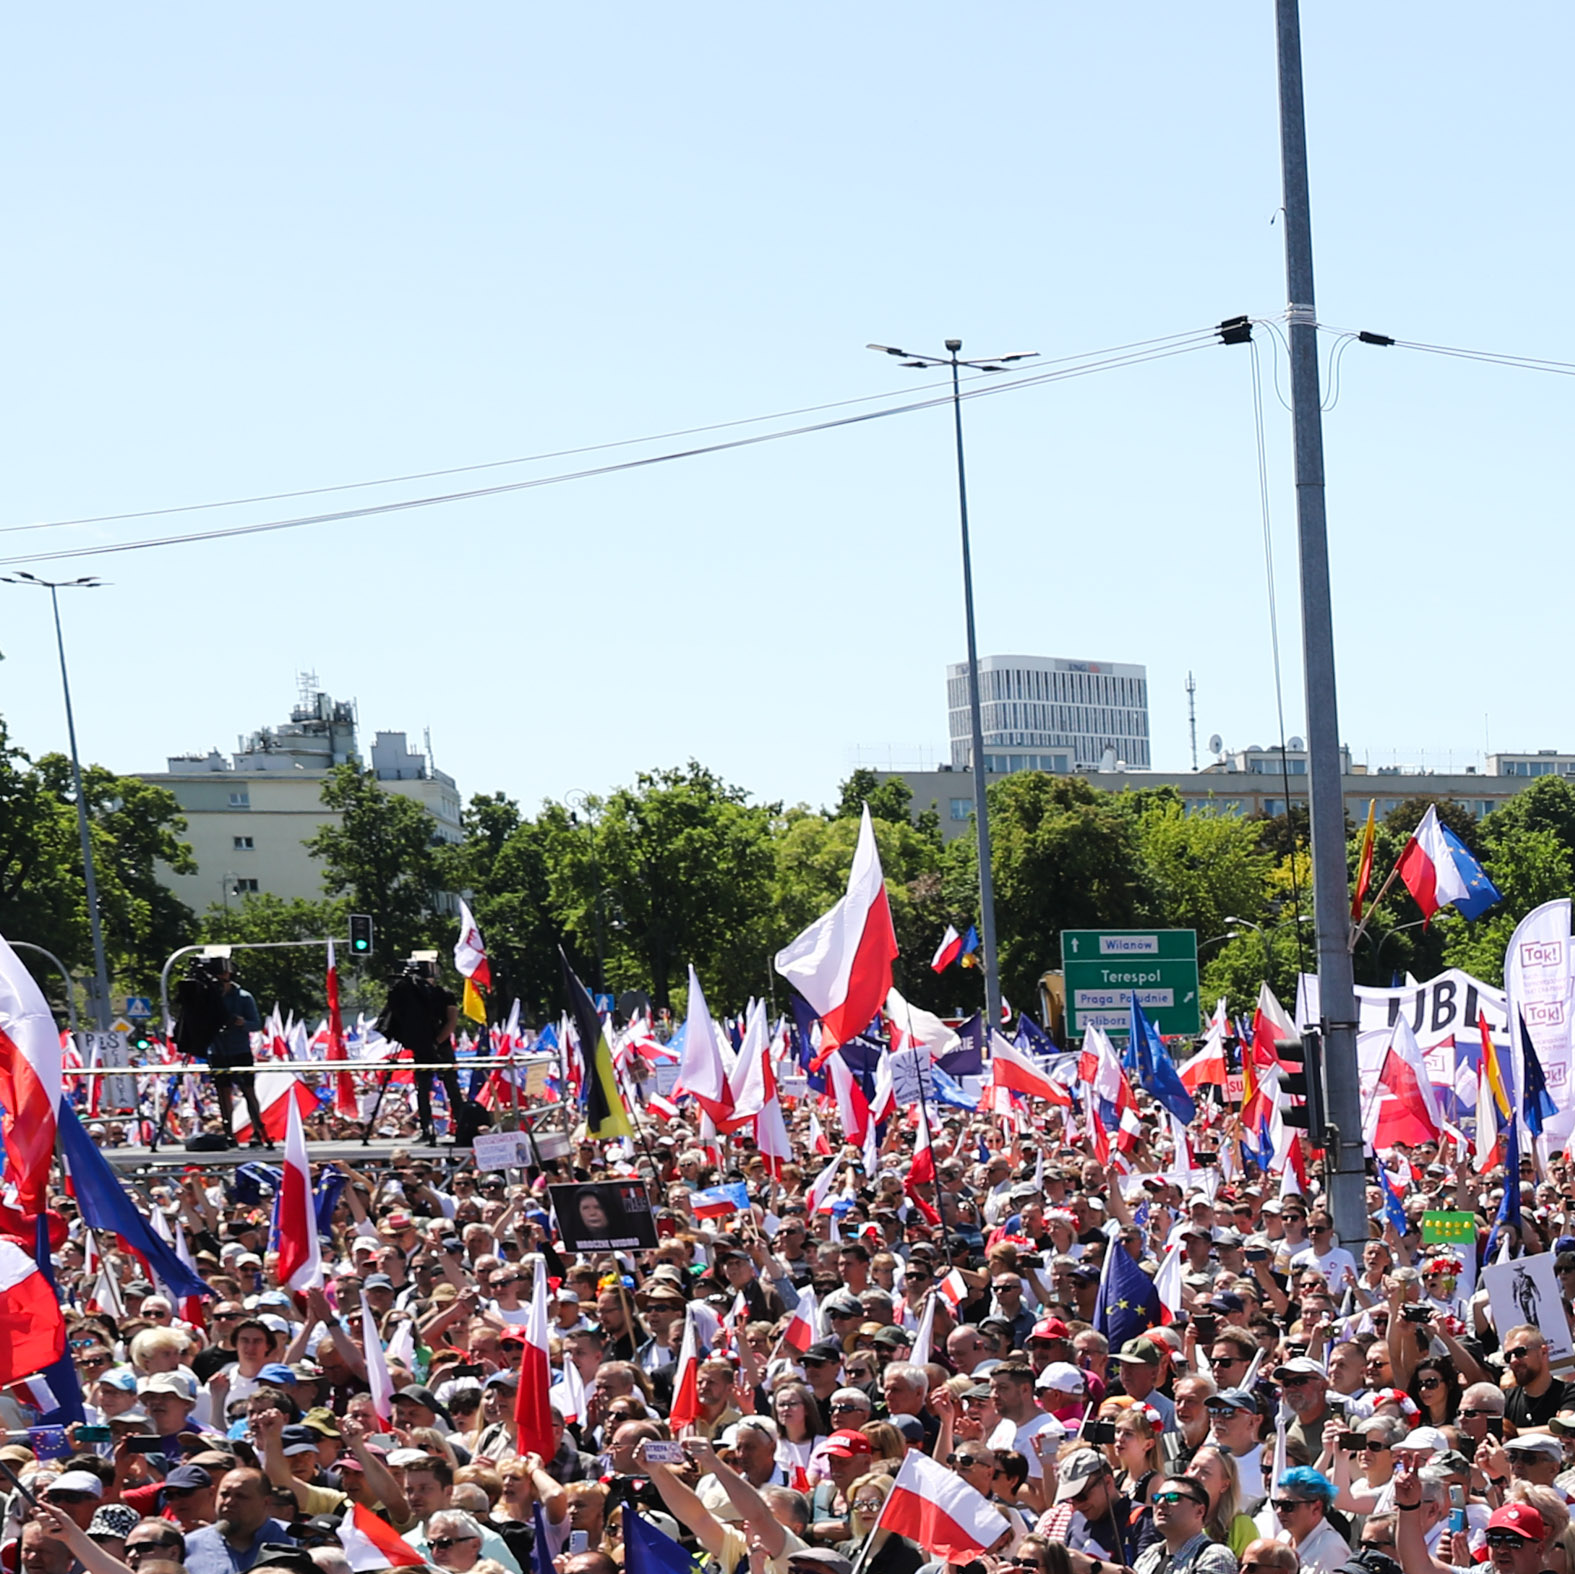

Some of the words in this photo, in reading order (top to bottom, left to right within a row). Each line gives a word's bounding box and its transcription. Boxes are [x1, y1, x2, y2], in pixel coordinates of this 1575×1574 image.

[1524, 947, 1557, 963] Tak!
[1101, 969, 1161, 986] Terespol
[1080, 994, 1113, 1006] Praga
[1120, 993, 1169, 1004] Poudnie
[1529, 1005, 1560, 1021] Tak!
[1544, 1067, 1562, 1081] ak!
